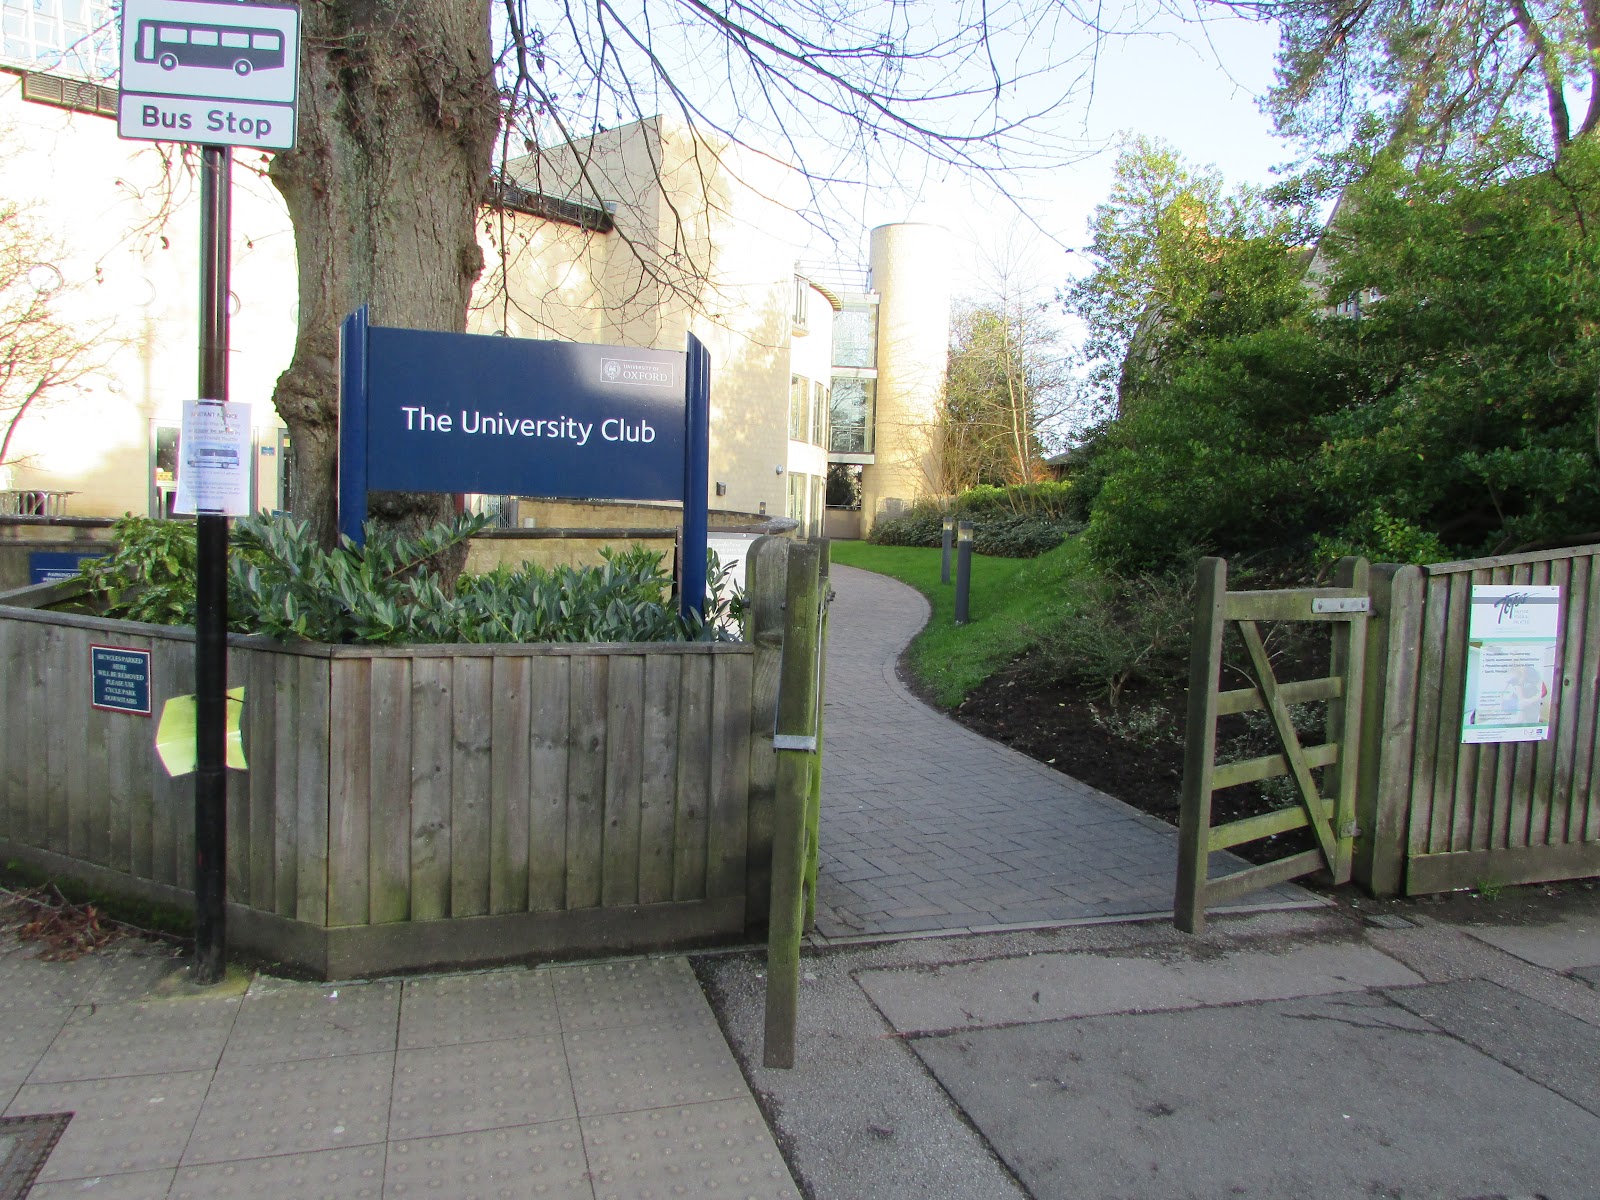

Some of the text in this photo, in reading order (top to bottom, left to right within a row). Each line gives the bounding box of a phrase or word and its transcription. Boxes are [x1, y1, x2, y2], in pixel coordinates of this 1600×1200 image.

[142, 104, 272, 140] Bus Stop
[623, 370, 668, 382] OXFORD
[401, 406, 656, 446] The University Club
[122, 656, 143, 664] PARKED
[118, 672, 144, 680] REMOVED
[104, 695, 137, 704] DOWNSTAIRS
